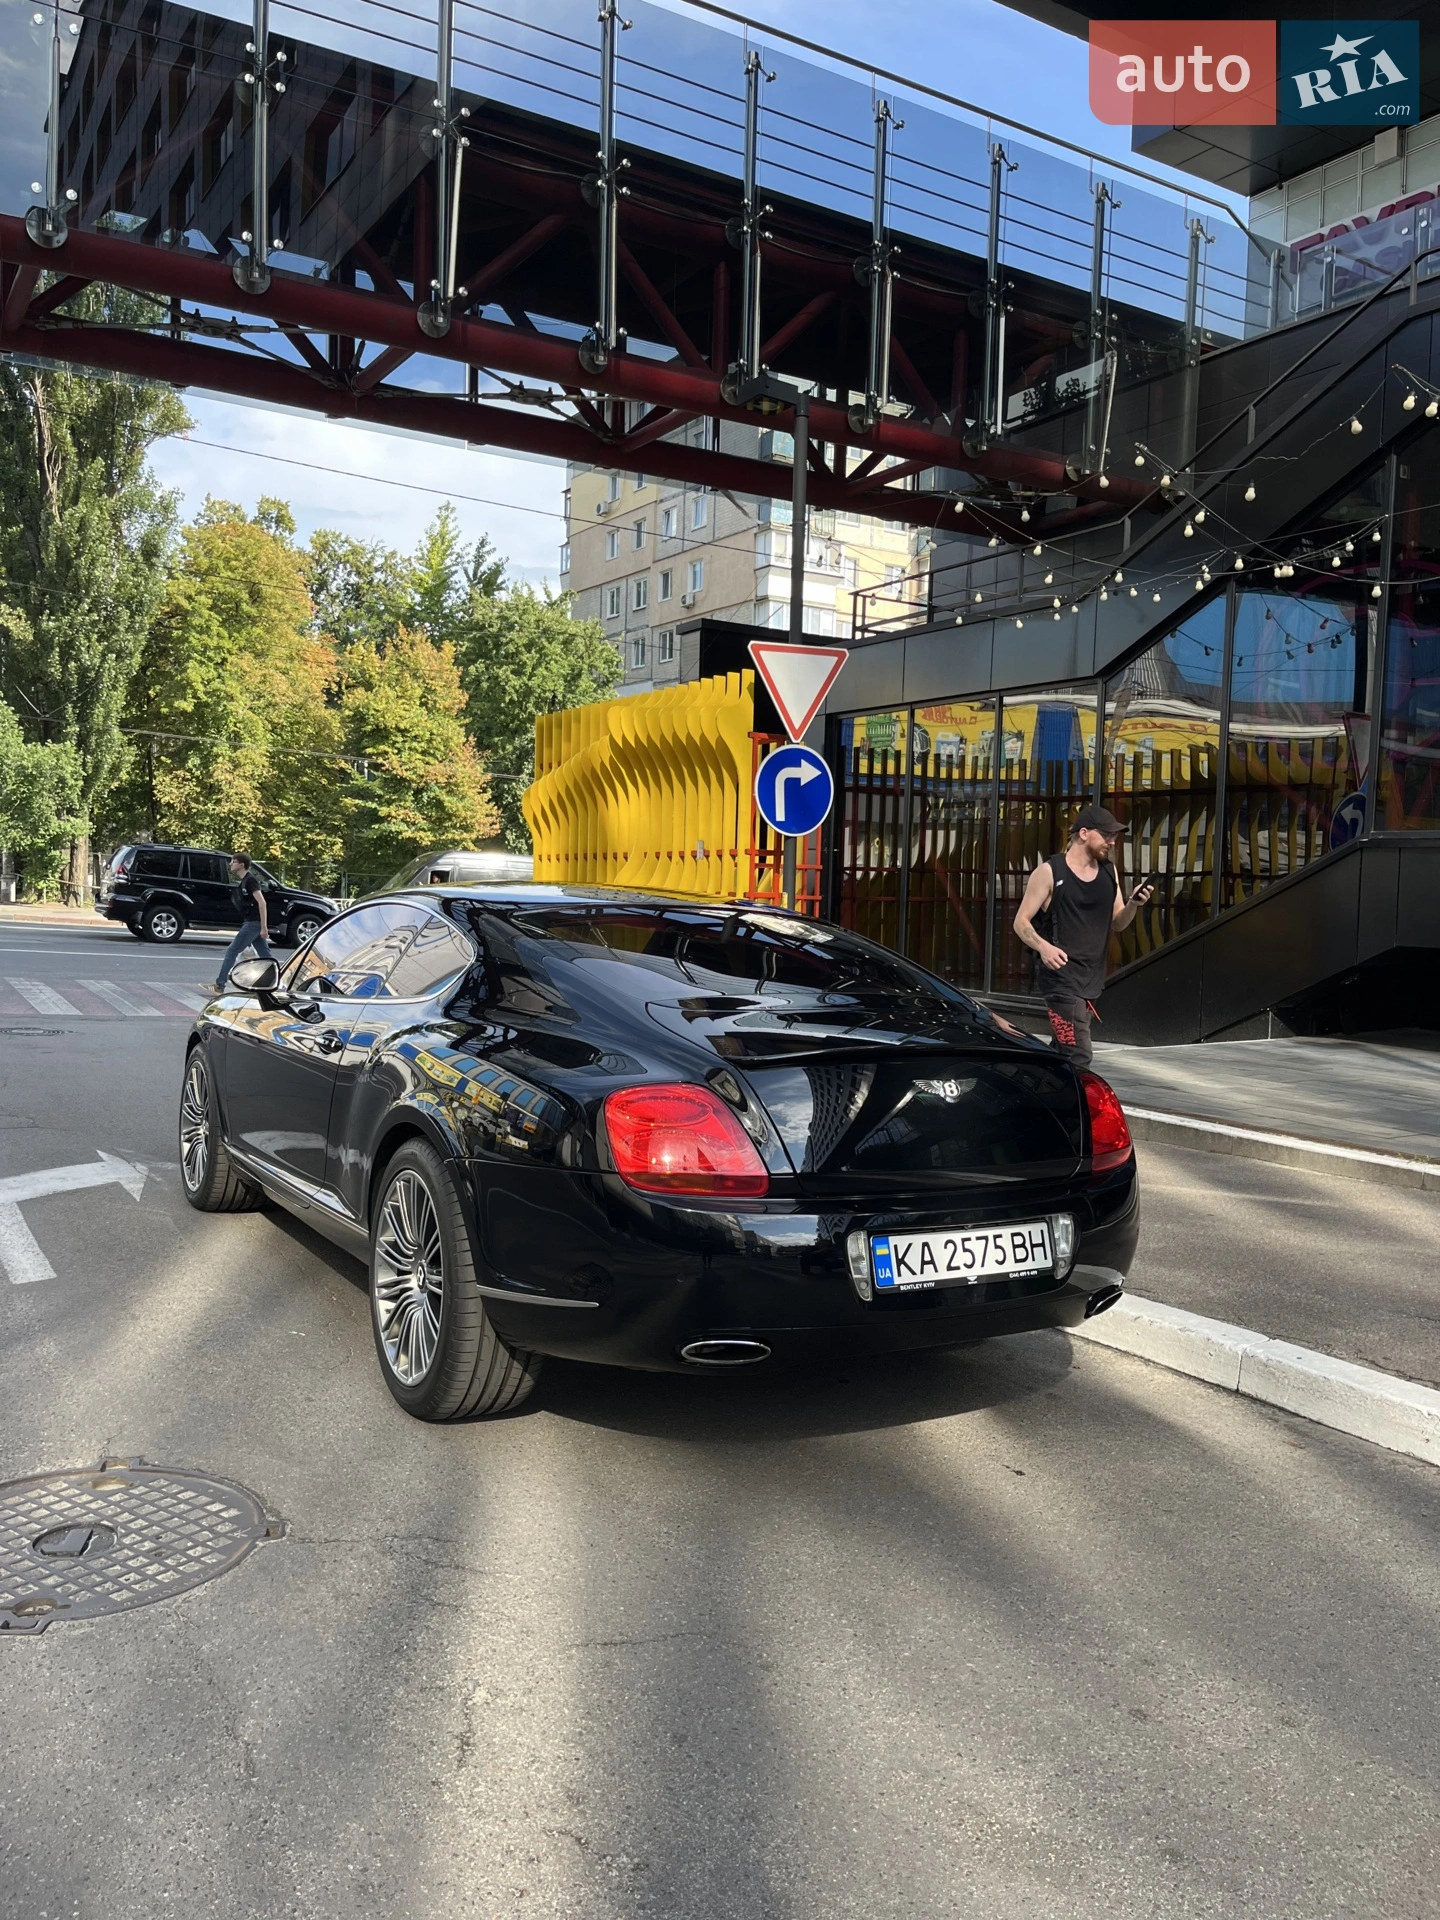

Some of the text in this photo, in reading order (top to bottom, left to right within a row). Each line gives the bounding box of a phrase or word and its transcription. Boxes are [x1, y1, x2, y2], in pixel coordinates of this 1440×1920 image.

[893, 1229, 1048, 1278] KA 2575 BH
[878, 1267, 892, 1279] UA
[900, 1282, 923, 1291] BENTLEY
